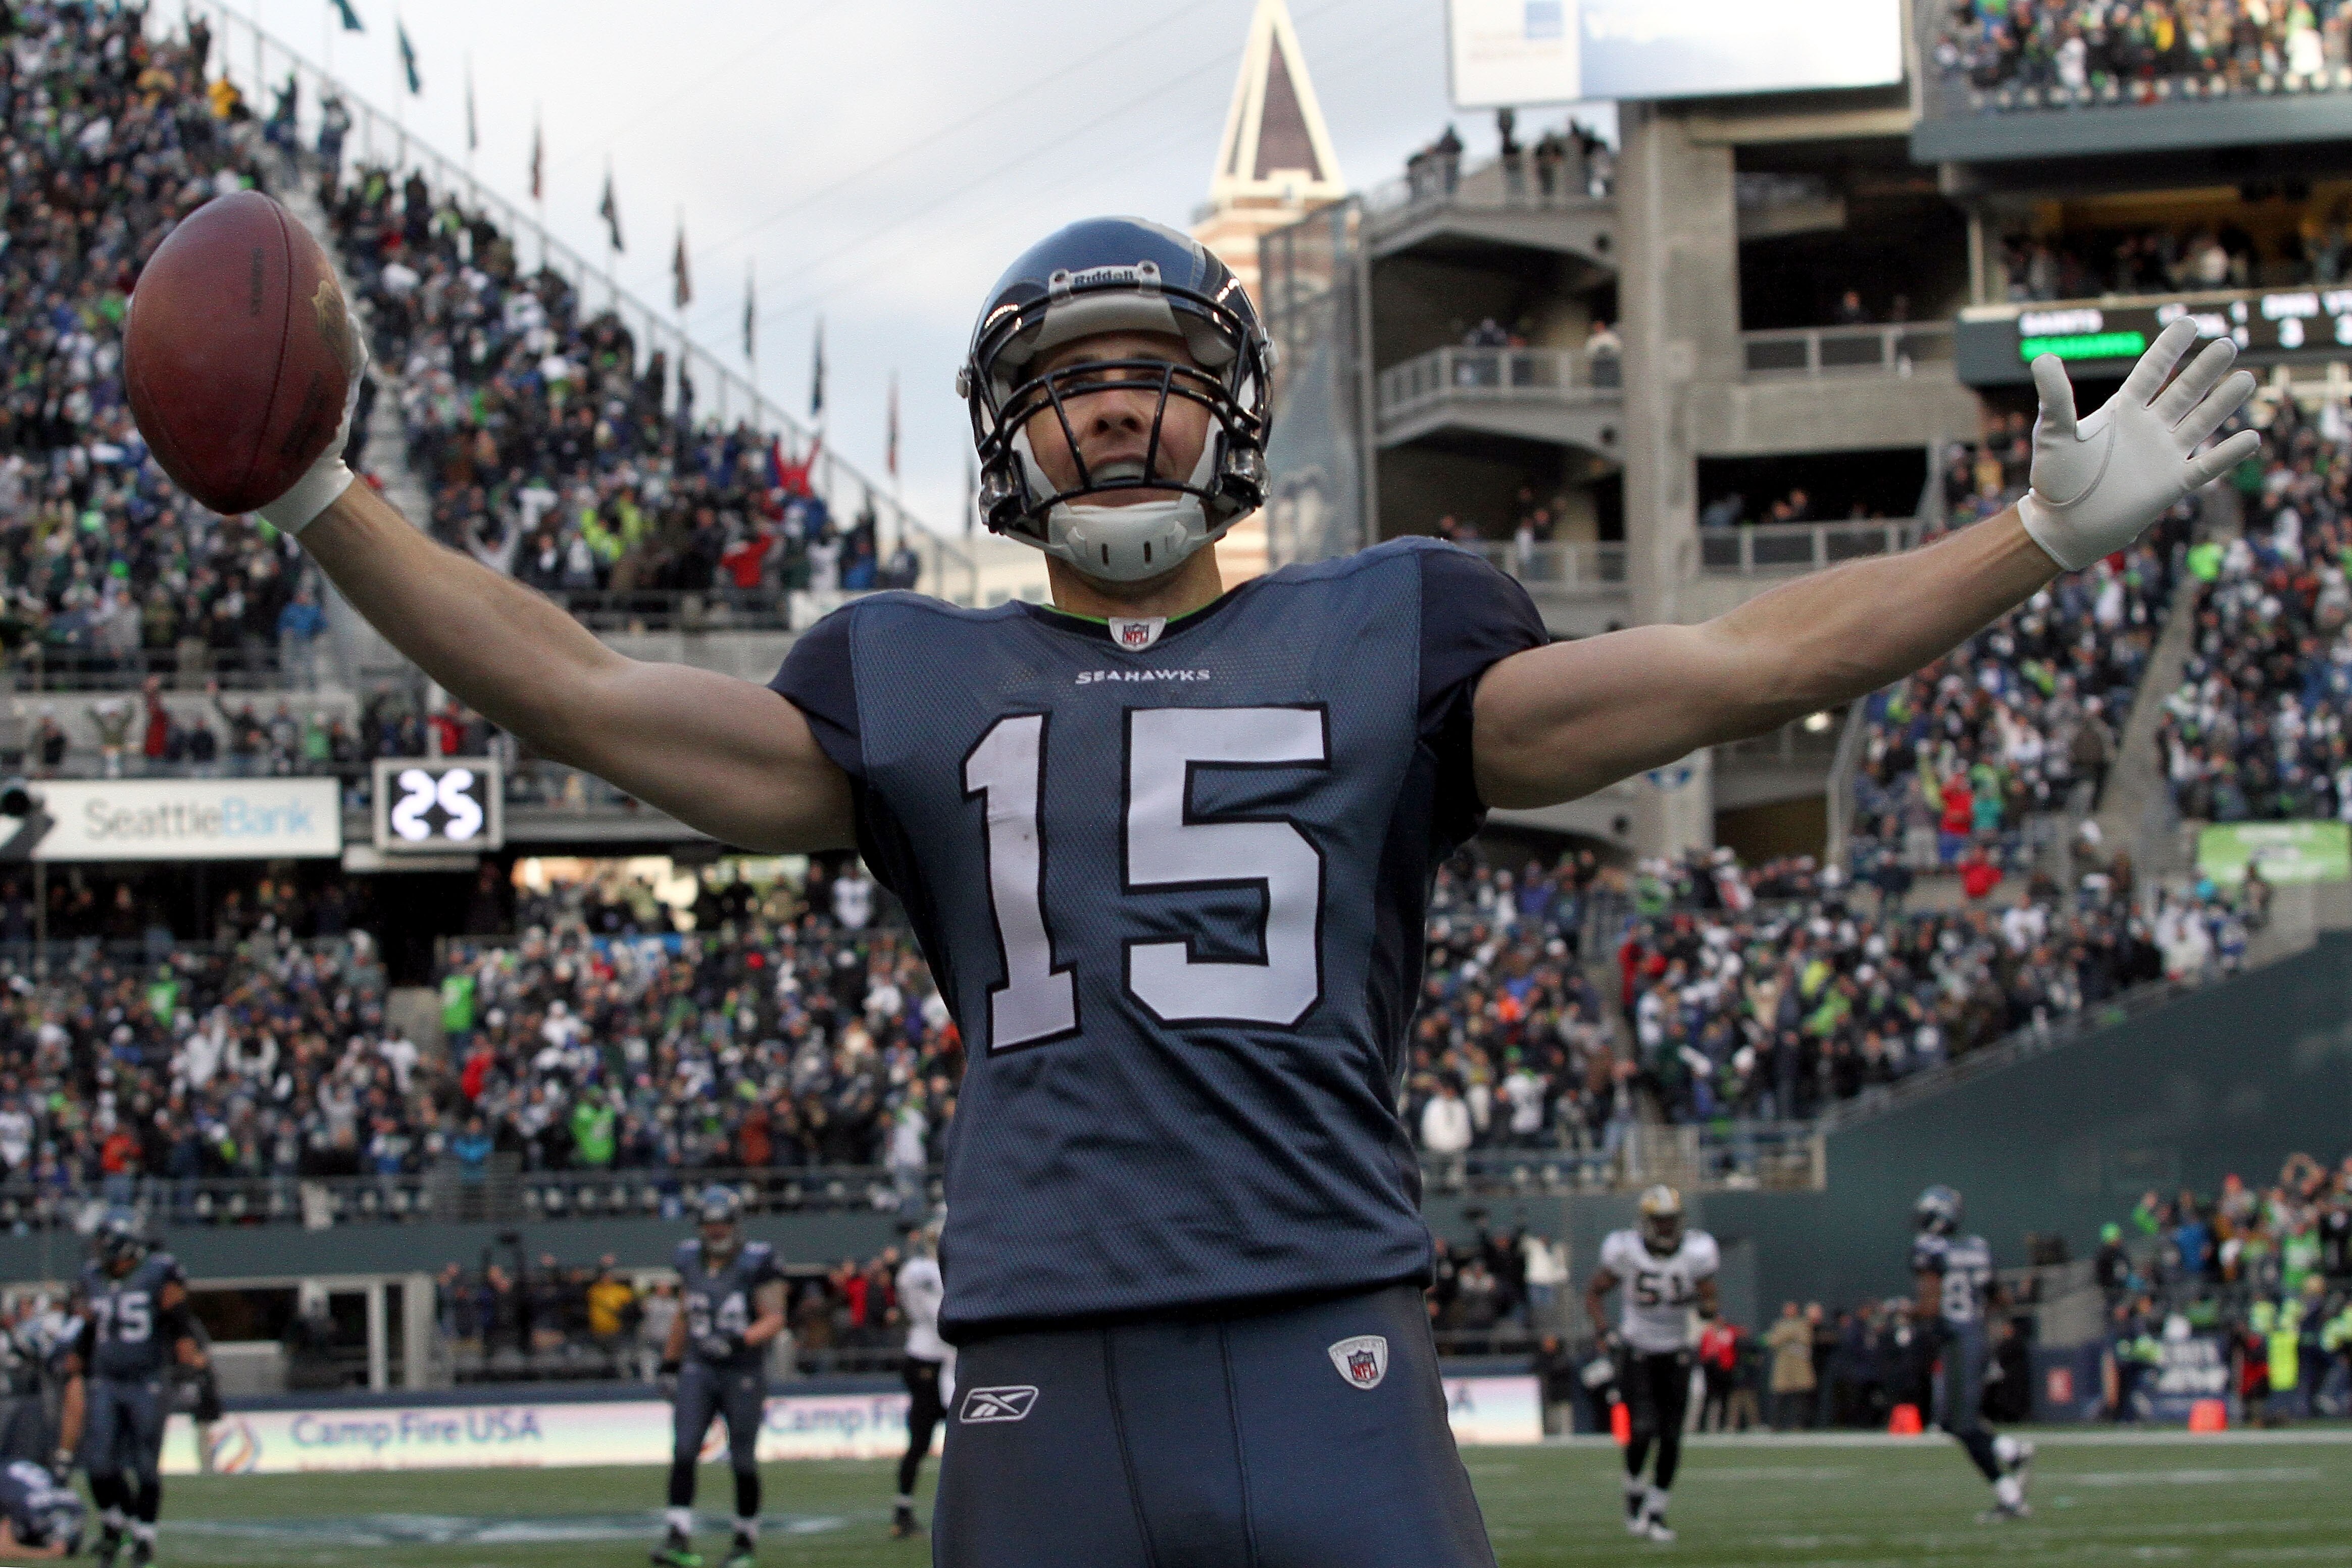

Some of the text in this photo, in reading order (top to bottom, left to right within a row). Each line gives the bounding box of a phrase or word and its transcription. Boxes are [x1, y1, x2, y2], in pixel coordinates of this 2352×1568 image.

[1074, 270, 1133, 284] Riddell
[1075, 669, 1211, 684] SEAHAWKS
[391, 768, 483, 842] 25
[961, 702, 1331, 1057] 15
[1636, 1270, 1687, 1307] 51
[1351, 1362, 1377, 1380] NFL
[289, 1408, 543, 1451] Camp Fire USA
